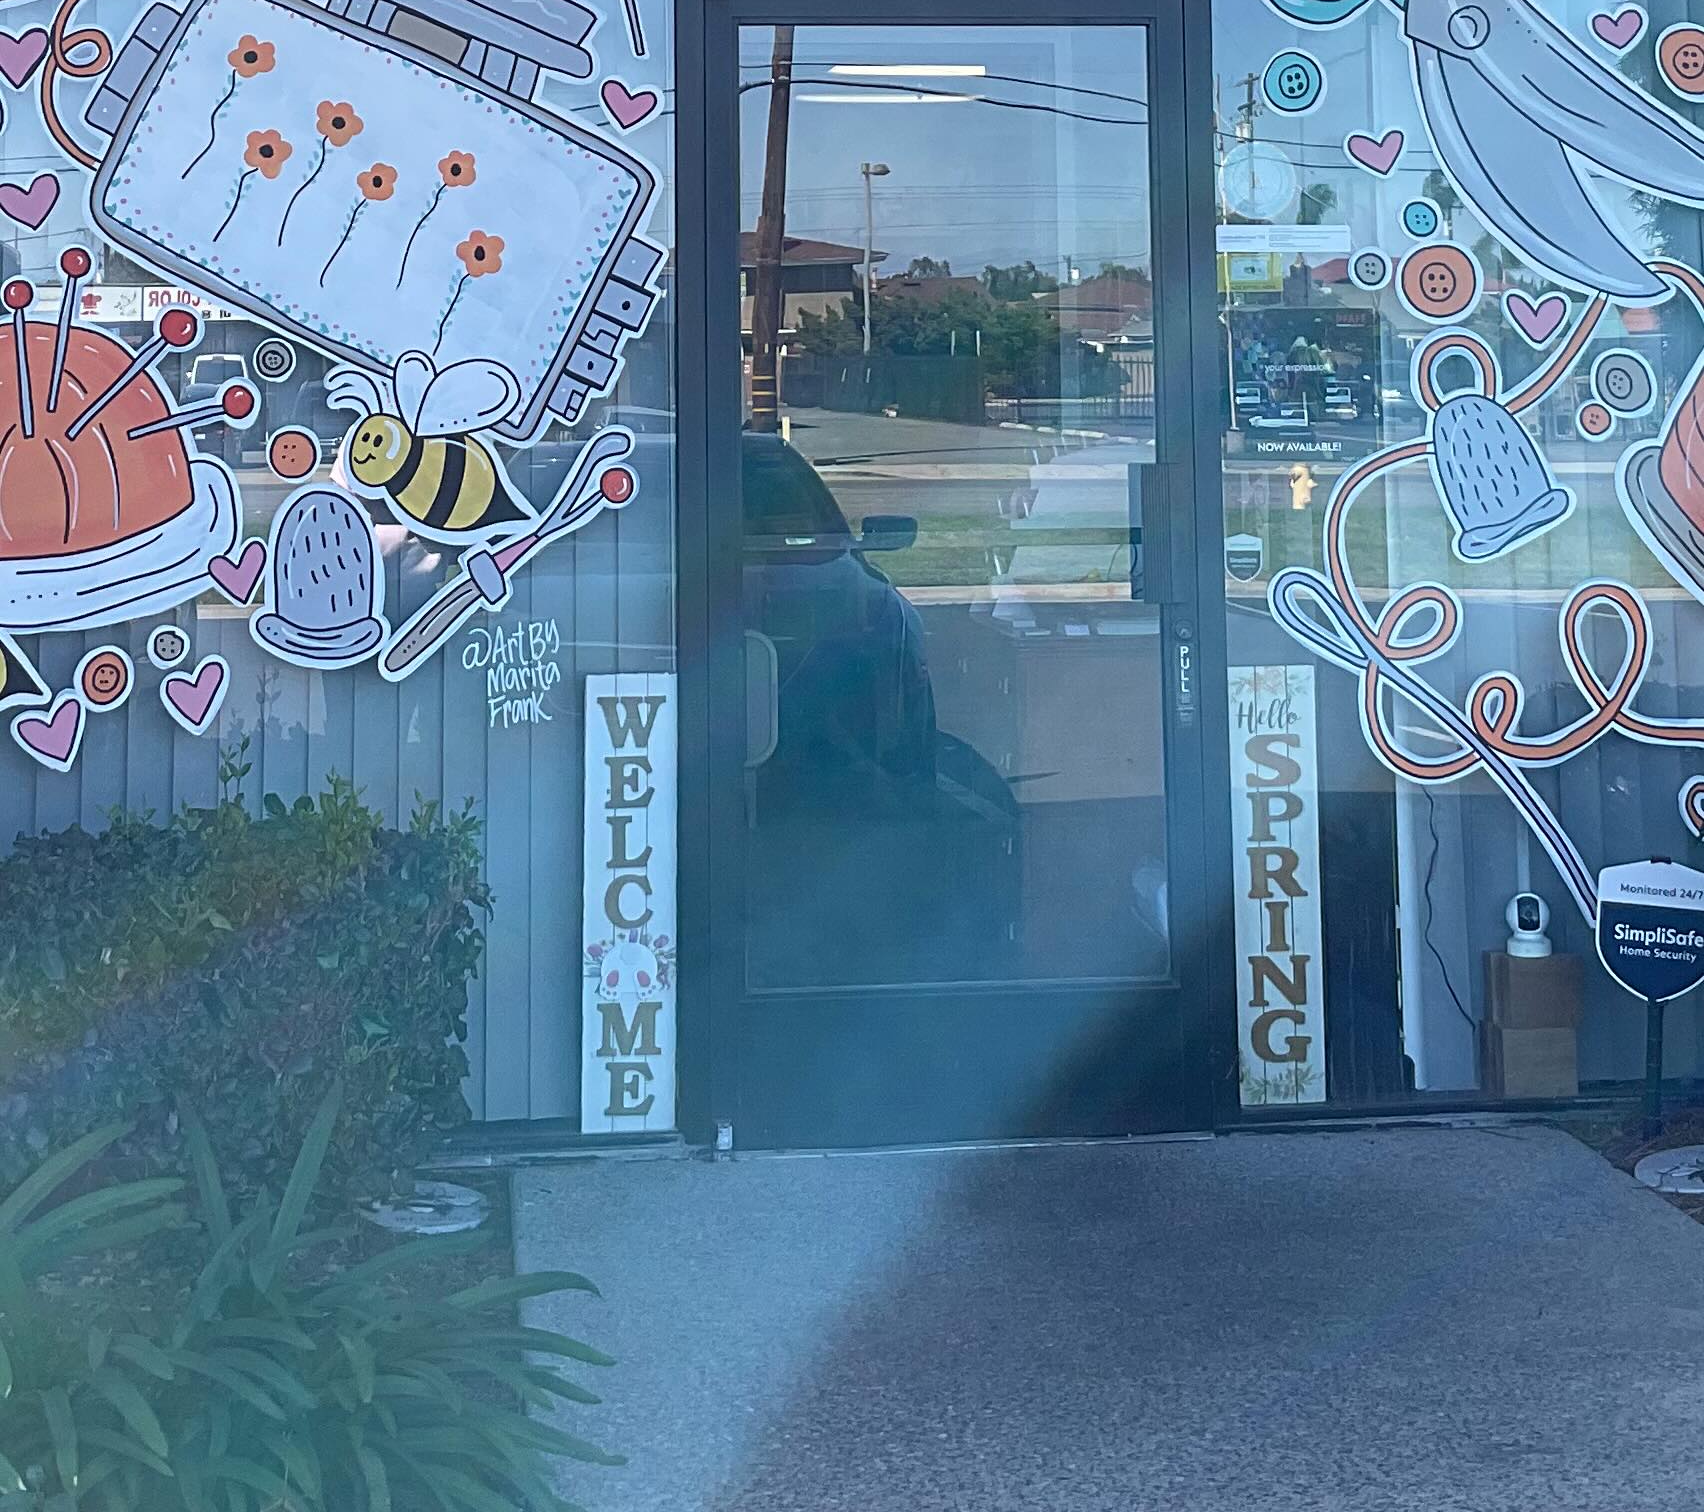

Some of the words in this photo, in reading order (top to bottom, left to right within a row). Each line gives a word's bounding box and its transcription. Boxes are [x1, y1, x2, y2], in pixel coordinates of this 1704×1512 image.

[1257, 442, 1285, 452] NOW
[1286, 442, 1342, 452] AVAILABLE!
[487, 661, 561, 697] Marita
[1180, 645, 1191, 693] PULL
[487, 691, 552, 728] Frank
[1236, 697, 1302, 734] Hello
[597, 695, 667, 1116] WELCME
[1244, 733, 1312, 1064] SPRING
[1620, 883, 1677, 898] Monitored
[1679, 888, 1704, 900] 24/7
[1613, 923, 1704, 948] SimpliSafe
[1619, 945, 1651, 958] Home
[1653, 948, 1697, 964] Security
